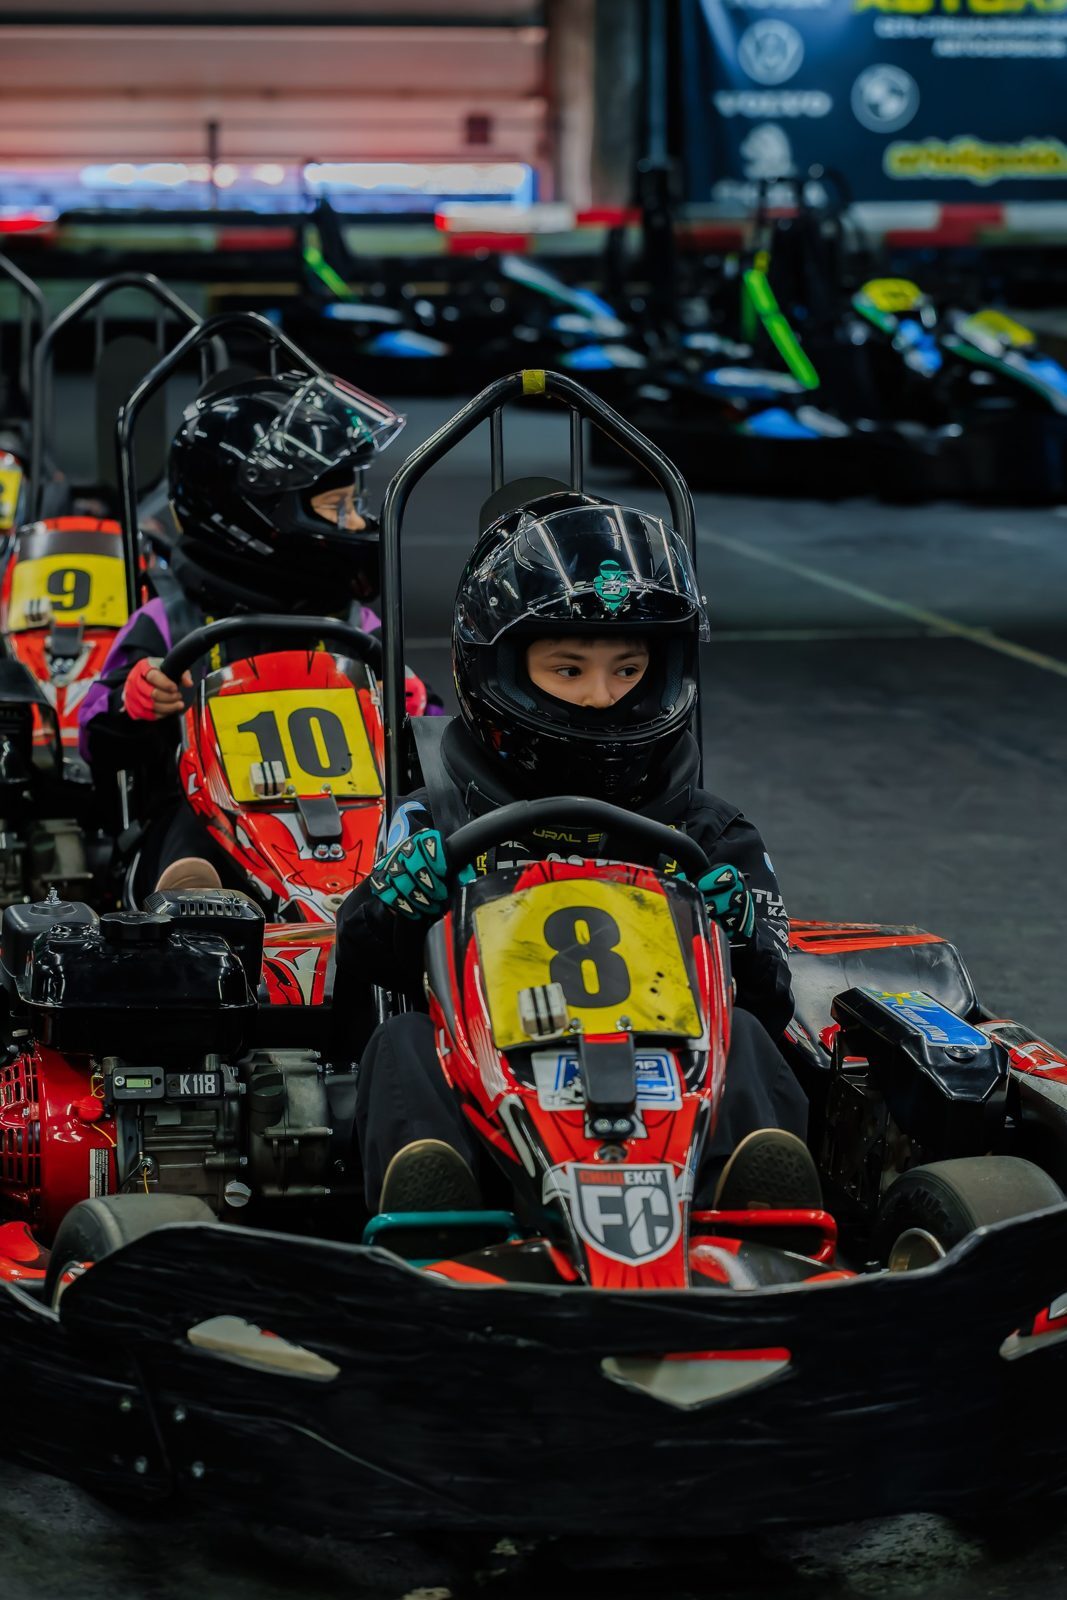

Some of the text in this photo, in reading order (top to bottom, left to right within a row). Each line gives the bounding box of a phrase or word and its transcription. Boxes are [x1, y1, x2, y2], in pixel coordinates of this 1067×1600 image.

[47, 568, 91, 611] 9
[237, 707, 353, 779] 10
[543, 905, 631, 1009] 8
[180, 1074, 216, 1094] K118
